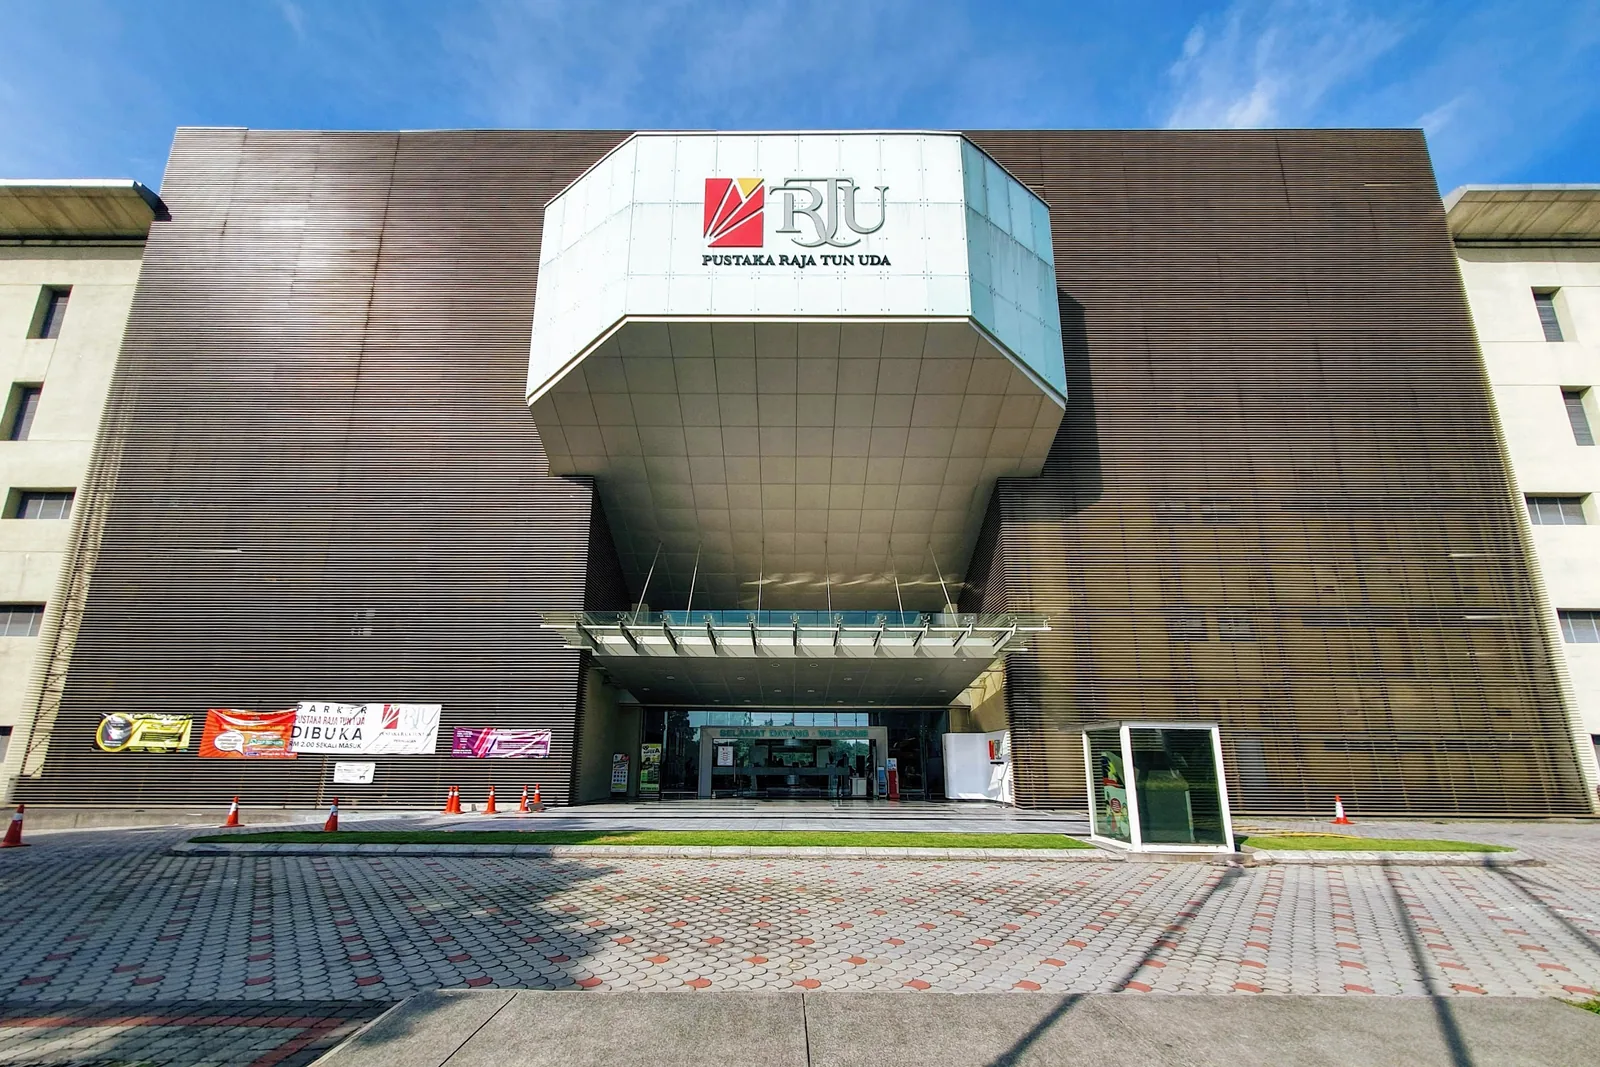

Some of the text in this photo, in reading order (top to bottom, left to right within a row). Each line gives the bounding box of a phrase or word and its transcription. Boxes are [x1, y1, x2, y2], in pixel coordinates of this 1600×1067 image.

[702, 254, 891, 269] PUSTAKA RAJA TUN UDA
[293, 714, 321, 725] PUSTAKA
[291, 726, 362, 740] DIBUKA
[719, 729, 869, 737] SELAMAT DATANG WELCOME
[316, 741, 338, 749] SEKALI
